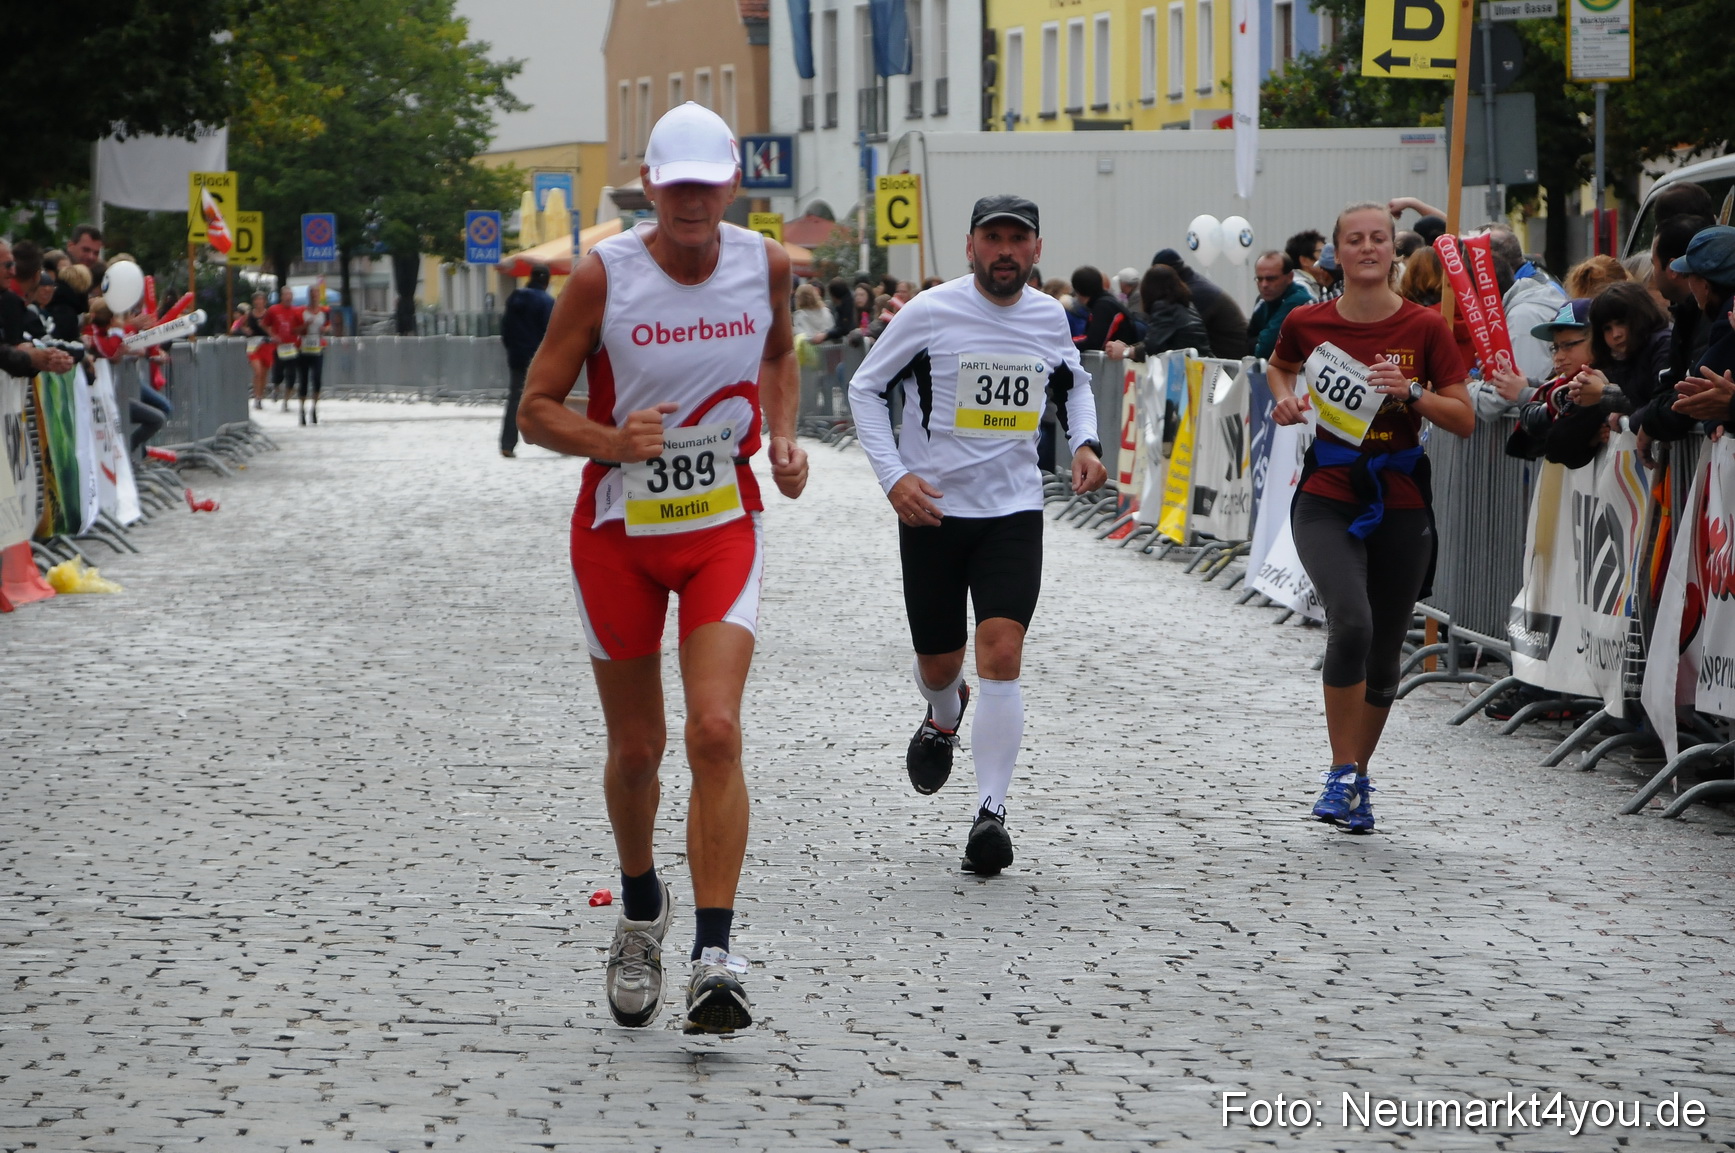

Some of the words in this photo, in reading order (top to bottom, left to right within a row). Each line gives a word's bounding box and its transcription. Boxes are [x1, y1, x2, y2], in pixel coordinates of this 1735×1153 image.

[1494, 4, 1521, 15] Ulmer
[1524, 2, 1552, 14] Gasse
[1580, 16, 1620, 25] Marktplatz
[194, 173, 231, 187] Block
[879, 177, 917, 190] Block
[887, 195, 910, 229] C
[752, 215, 780, 225] Block
[235, 228, 253, 252] D
[307, 247, 333, 258] TAXI
[471, 248, 497, 260] TAXI
[1472, 246, 1494, 290] Audi
[1483, 294, 1504, 333] BKK
[1458, 287, 1483, 324] BKK
[631, 312, 756, 346] Oberbank
[1316, 346, 1339, 366] PARTL
[1385, 354, 1415, 365] 2011
[960, 361, 991, 371] PARTL
[992, 363, 1033, 372] Neumarkt
[975, 375, 1030, 407] 348
[1315, 364, 1367, 412] 586
[983, 413, 1017, 428] Bernd
[663, 435, 718, 450] Neumarkt
[645, 450, 717, 494] 389
[660, 500, 709, 519] Martin
